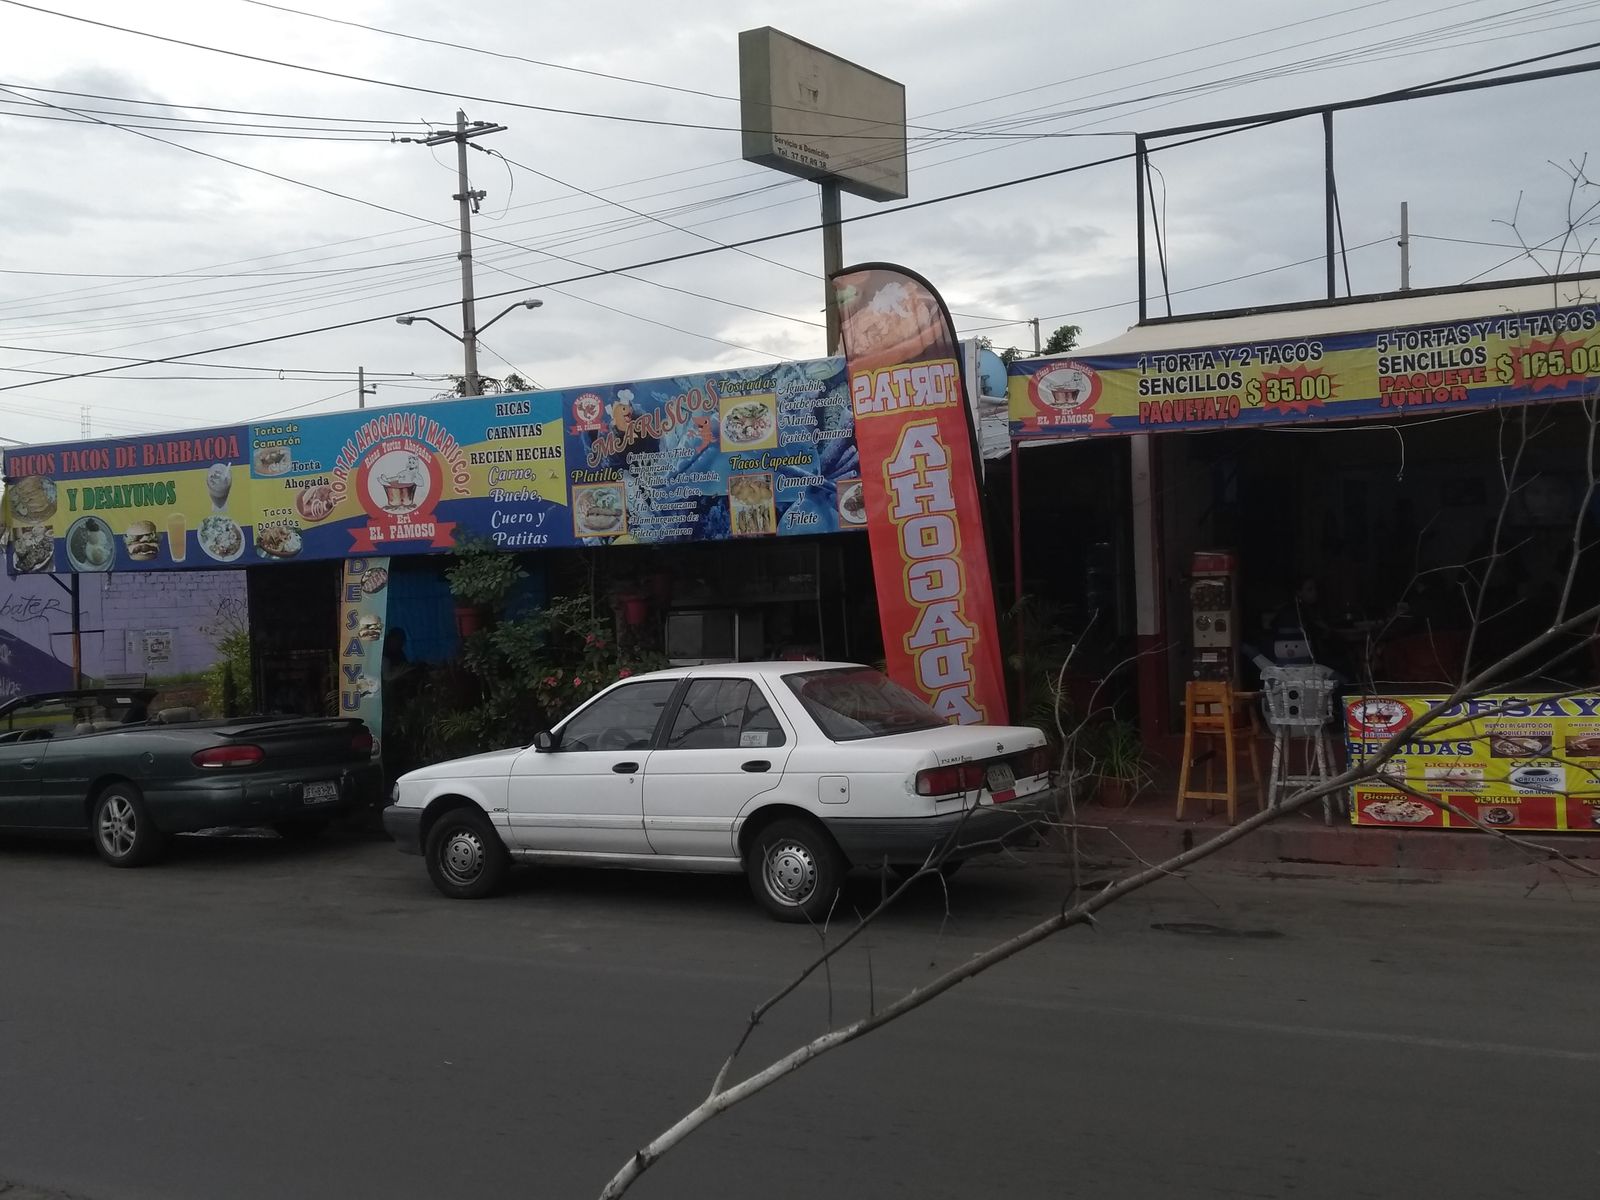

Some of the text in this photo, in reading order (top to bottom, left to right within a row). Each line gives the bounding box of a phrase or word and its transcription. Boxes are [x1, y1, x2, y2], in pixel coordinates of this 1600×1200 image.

[774, 135, 798, 150] Servicio
[803, 145, 830, 159] Domicilio
[777, 147, 789, 157] Tel.
[791, 151, 799, 160] 37
[819, 160, 827, 169] 38
[1377, 310, 1597, 353] 5 TORTAS Y 15 TACOS
[1138, 342, 1323, 375] 1 TORTA Y 2 TACOS
[1377, 346, 1487, 374] SENCILLOS
[1496, 344, 1600, 383] $ 165.00
[717, 378, 777, 393] Tostadas
[778, 380, 826, 397] Aguachile,
[1138, 371, 1243, 396] SENCILLOS
[1378, 366, 1488, 392] PAQUETE
[1246, 374, 1332, 406] $ 35.00
[1379, 386, 1469, 408] JUNIOR
[496, 401, 531, 417] RICAS
[779, 394, 846, 414] Ceviche pescado,
[1139, 395, 1241, 424] PAQUETAZO
[587, 380, 719, 468] MARISCOS
[779, 415, 818, 430] Marlin,
[1037, 414, 1094, 425] EL FAMOSO
[254, 424, 298, 437] Torta de
[487, 424, 542, 440] CARNITAS
[780, 428, 853, 447] Ceviche Camaron
[253, 437, 301, 449] Camarón
[404, 439, 432, 464] Ahogadas
[9, 435, 240, 478] RICOS TACOS DE BARBACOA
[330, 412, 471, 507] TORTAS AHOGADAS Y MARISCOS
[470, 445, 562, 465] RECIÉN HECHAS
[729, 452, 812, 472] Tacos Capeados
[291, 460, 321, 472] Torta
[571, 468, 624, 483] Platillos
[284, 476, 330, 490] Ahogada
[488, 466, 536, 486] Carne,
[776, 474, 824, 492] Camaron
[66, 480, 177, 511] Y DESAYUNOS
[489, 487, 542, 503] Buche,
[797, 491, 805, 505] y
[262, 507, 293, 517] Tacos
[491, 510, 545, 529] Cuero y
[786, 510, 818, 529] Filete
[258, 519, 299, 531] Dorados
[369, 523, 436, 541] EL FAMOSO
[492, 531, 548, 546] Patitas
[1349, 742, 1474, 756] BEIDAS
[1424, 761, 1488, 769] LICUADOS
